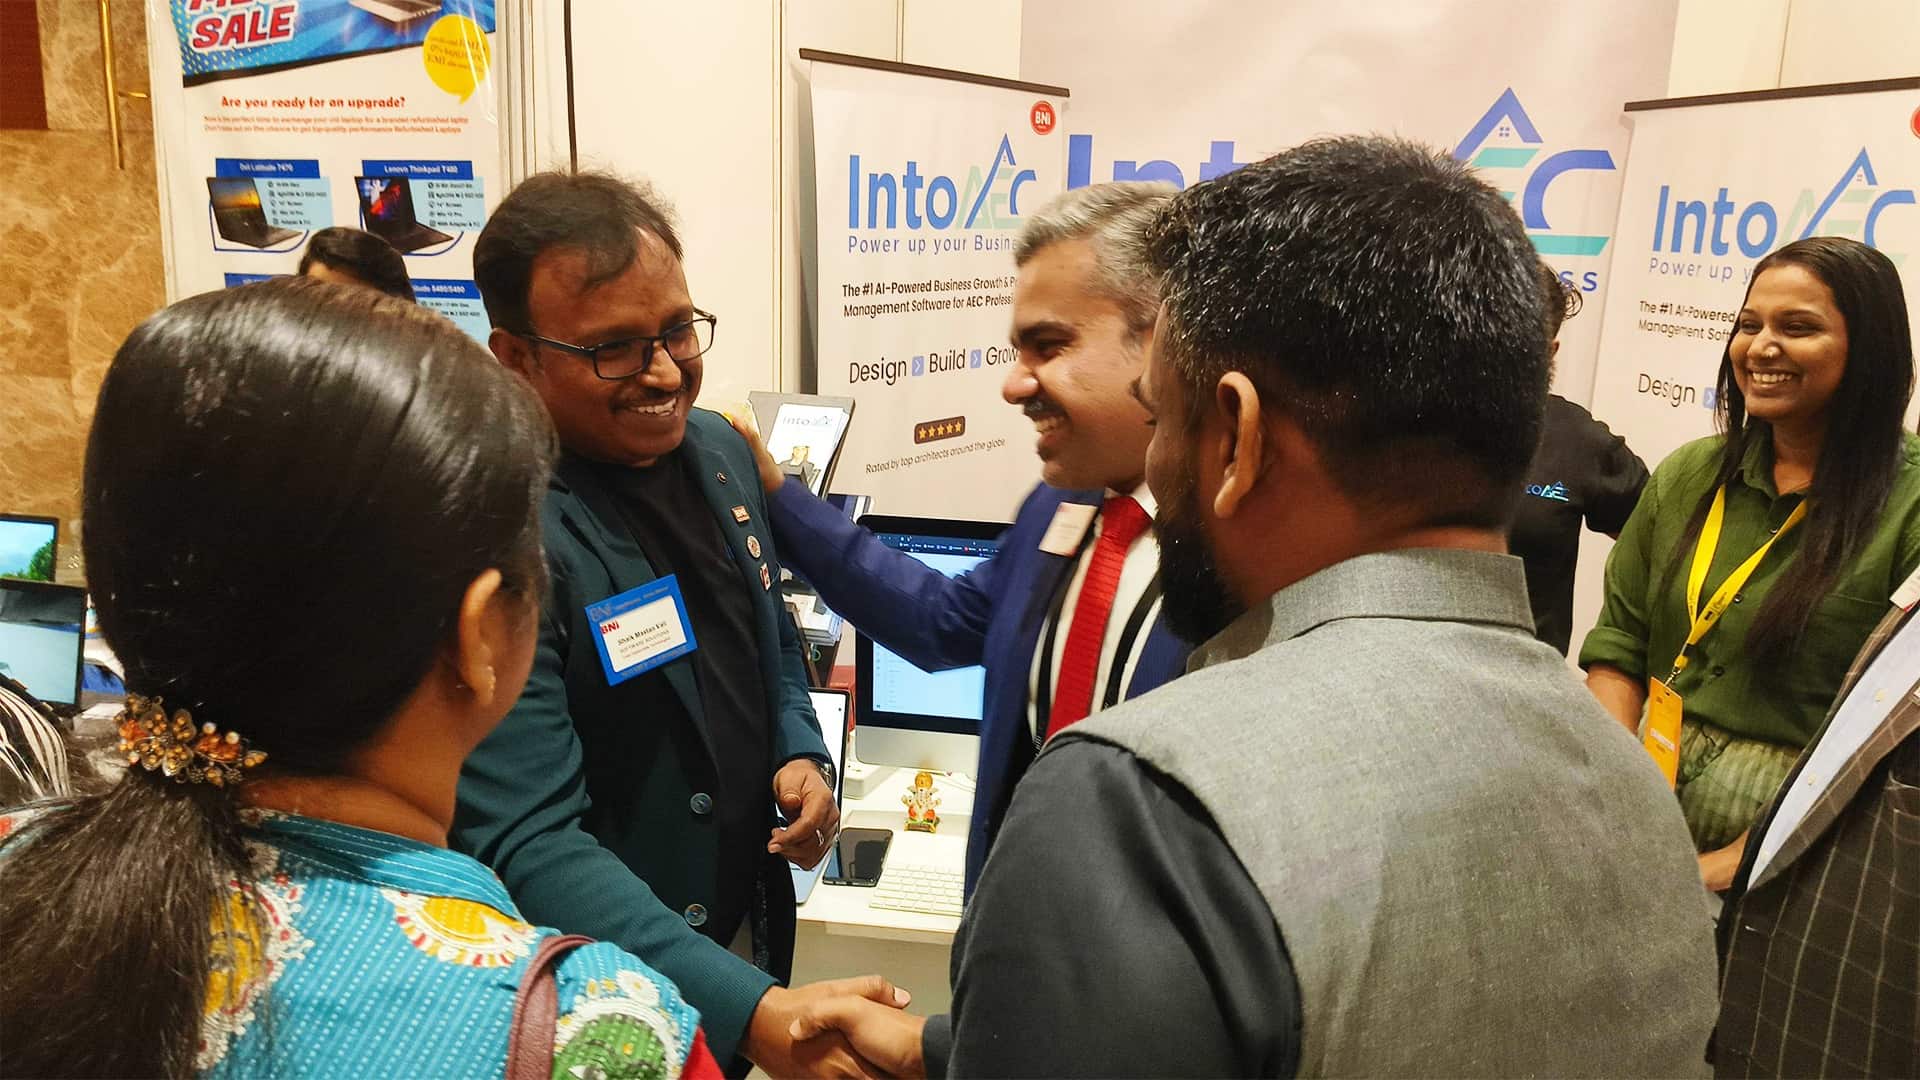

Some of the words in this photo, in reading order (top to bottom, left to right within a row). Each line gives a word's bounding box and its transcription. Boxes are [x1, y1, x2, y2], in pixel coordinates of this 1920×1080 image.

[193, 5, 295, 49] SALE
[222, 95, 241, 107] Are
[245, 99, 268, 109] you
[272, 96, 305, 109] ready
[309, 96, 324, 107] for
[329, 99, 344, 107] an
[348, 96, 405, 109] upgrade?
[384, 164, 408, 174] Lenovo
[848, 235, 900, 253] Power
[908, 238, 926, 255] up
[934, 238, 967, 255] your
[974, 234, 1017, 251] Busine
[1649, 257, 1702, 277] Power
[1709, 266, 1733, 283] up
[842, 284, 861, 297] The
[862, 283, 874, 296] #1
[875, 280, 932, 295] AI-Powered
[934, 278, 972, 292] Business
[973, 277, 1003, 290] Growth
[843, 301, 910, 319] Management
[911, 299, 951, 313] Software
[952, 297, 965, 310] for
[966, 296, 983, 308] AEC
[985, 293, 1015, 306] Professi
[1640, 301, 1657, 313] The
[1659, 303, 1673, 315] #1
[1675, 304, 1737, 323] AI-Powered
[1638, 319, 1704, 339] Management
[849, 357, 907, 386] Design
[929, 349, 966, 373] Build
[1638, 373, 1696, 407] Design
[865, 461, 890, 474] Rated
[890, 459, 900, 471] by
[900, 455, 914, 468] top
[914, 450, 950, 464] architects
[950, 443, 974, 457] around
[974, 440, 986, 451] the
